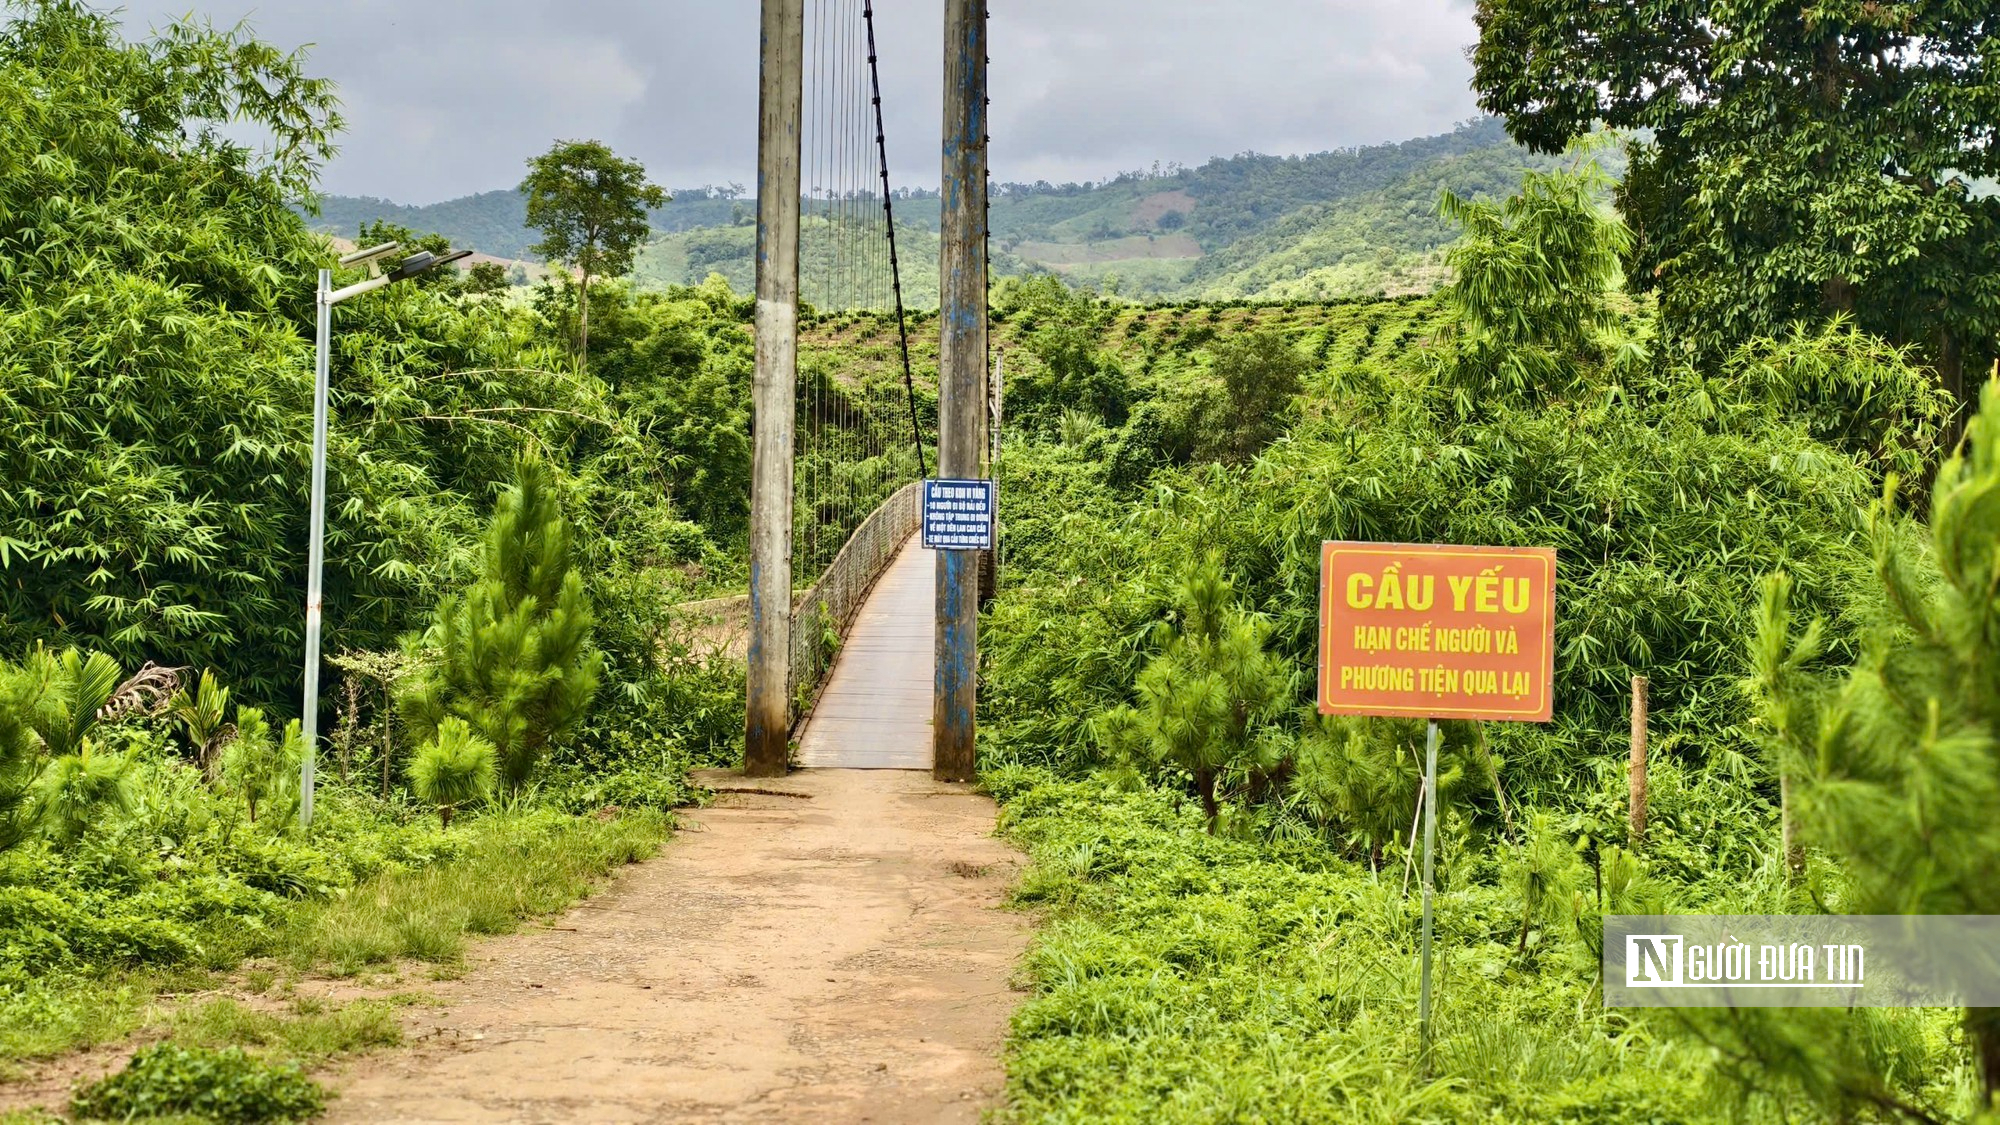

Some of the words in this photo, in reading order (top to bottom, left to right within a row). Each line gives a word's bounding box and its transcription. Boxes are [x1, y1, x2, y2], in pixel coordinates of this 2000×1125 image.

[1346, 561, 1435, 612] CẦU
[1447, 565, 1530, 614] YẾU
[1354, 625, 1392, 655] HẠN
[1395, 620, 1432, 651] CHẾ
[1435, 624, 1491, 654] NGƯỜI
[1495, 626, 1519, 655] VÀ
[1341, 664, 1415, 692] PHƯƠNG
[1418, 664, 1459, 698] TIỆN
[1463, 670, 1498, 696] QUA
[1502, 671, 1531, 700] LẠI
